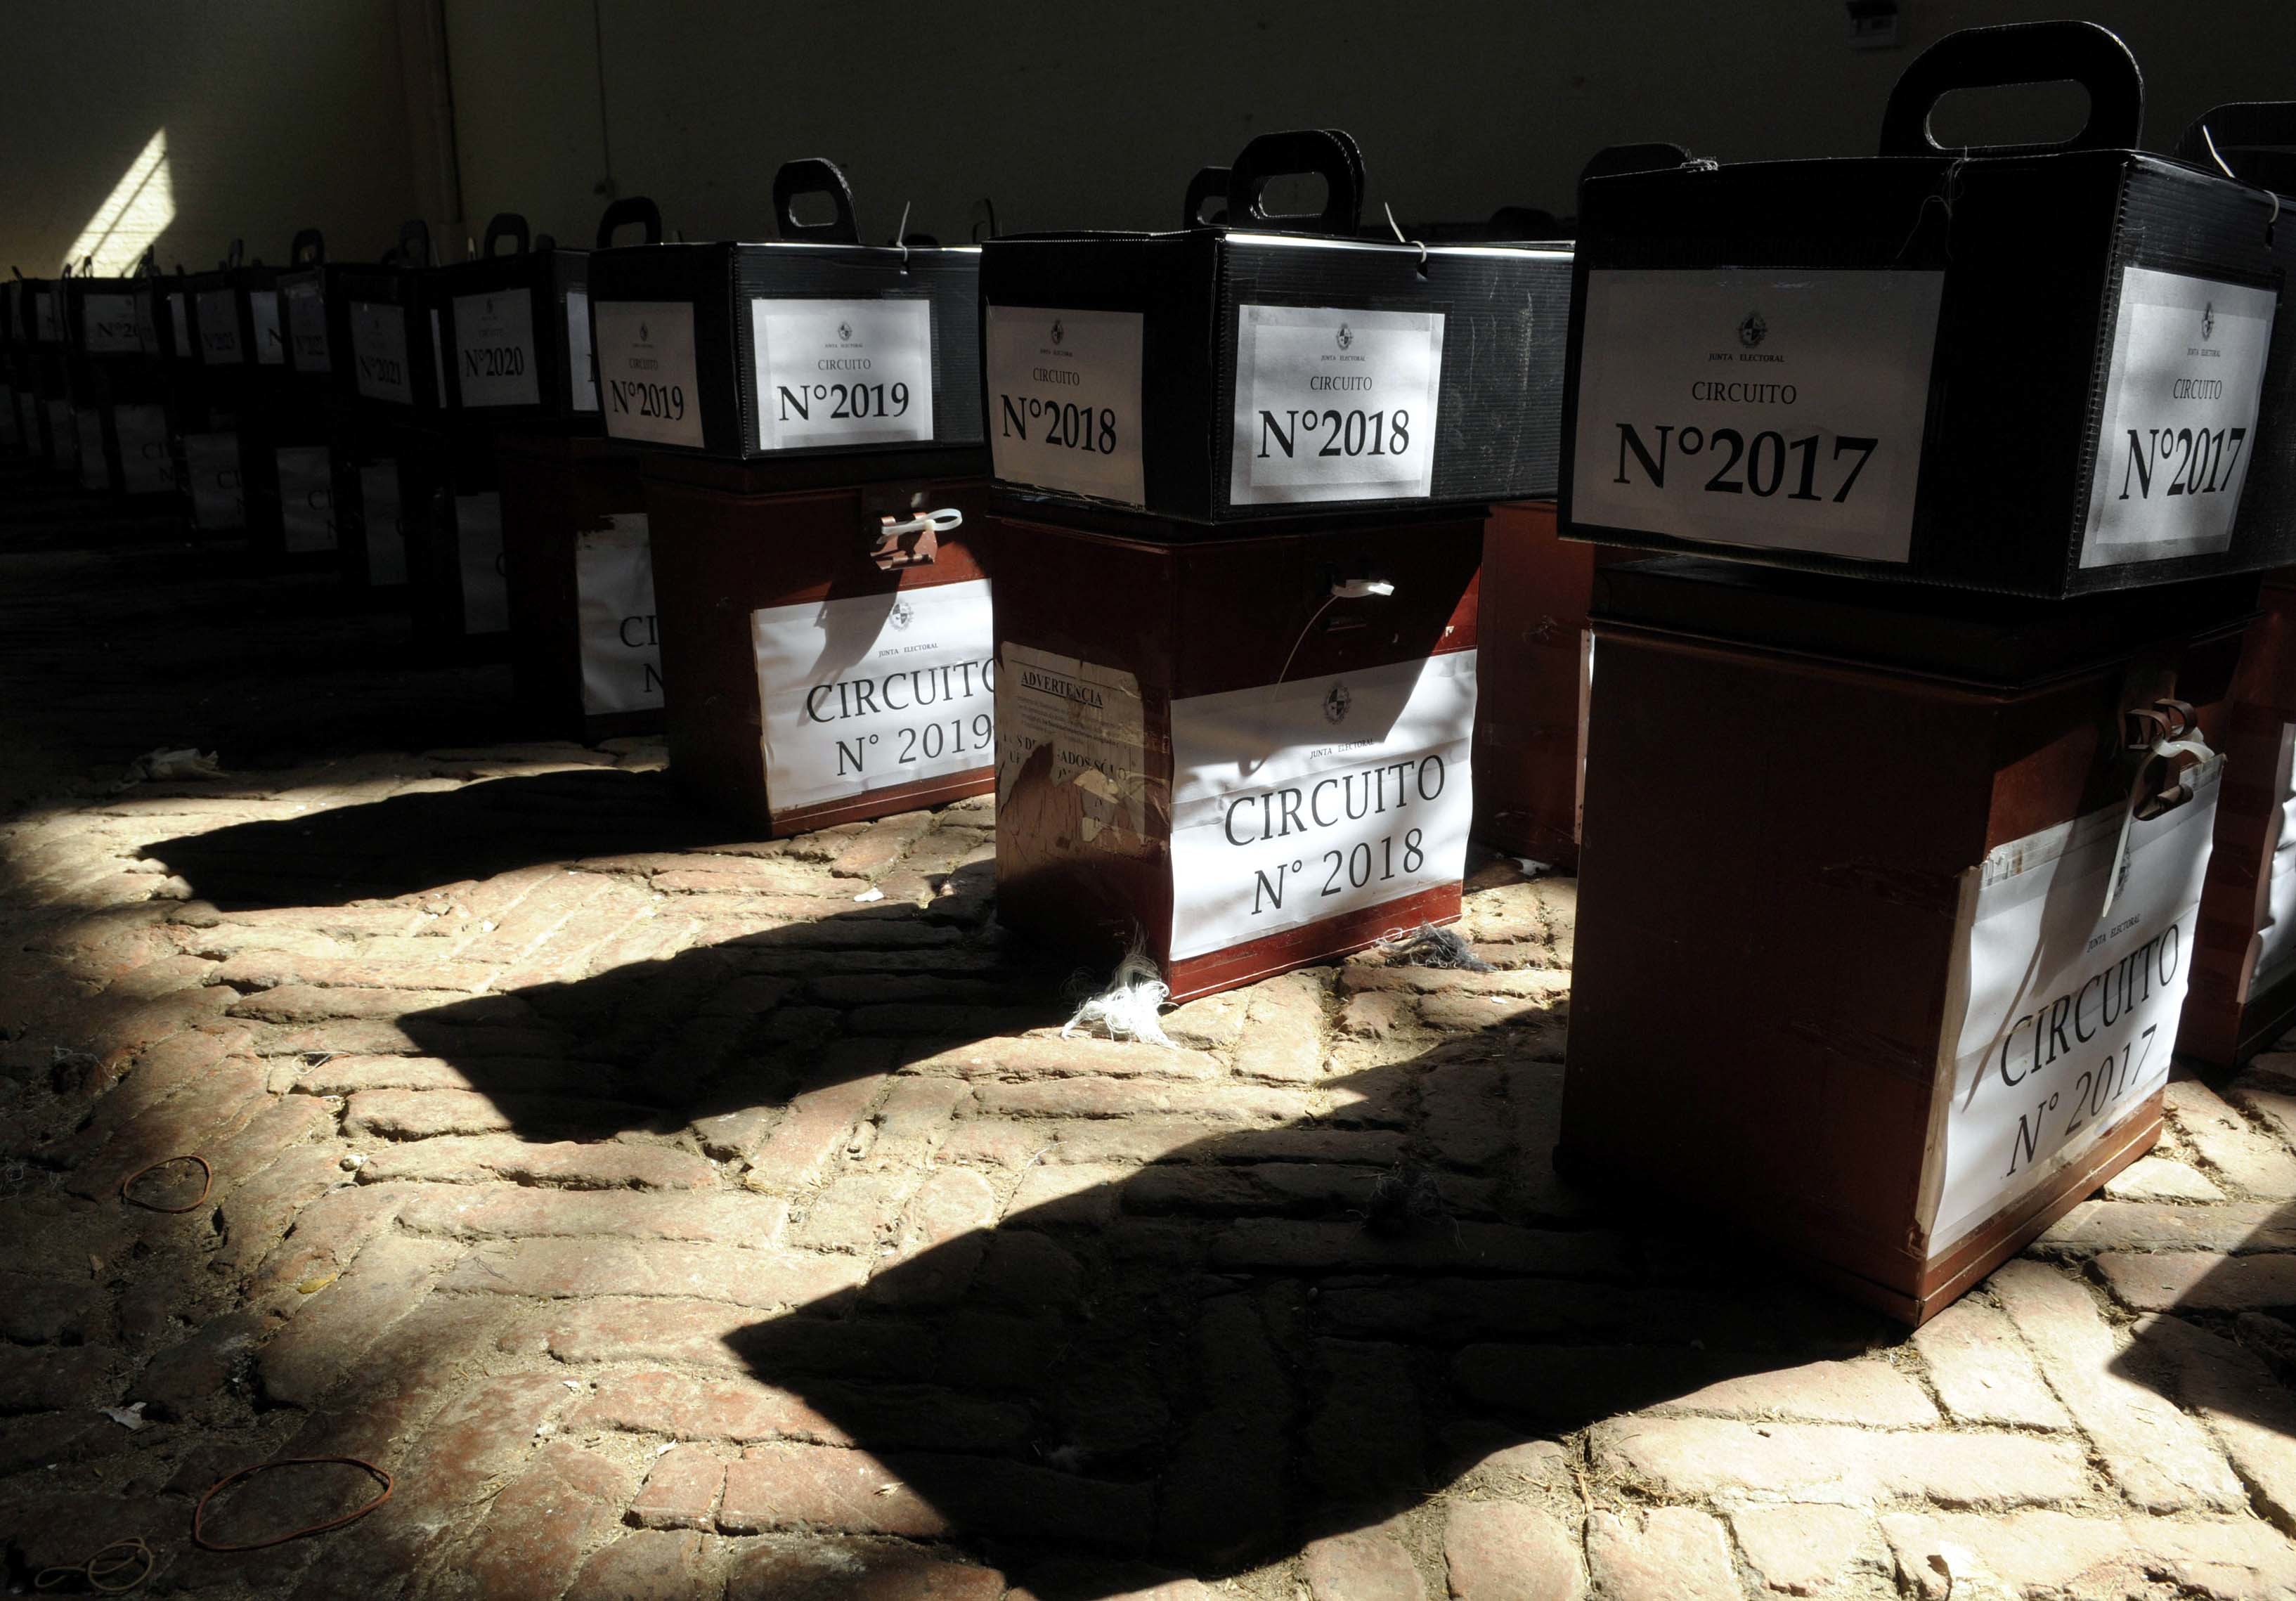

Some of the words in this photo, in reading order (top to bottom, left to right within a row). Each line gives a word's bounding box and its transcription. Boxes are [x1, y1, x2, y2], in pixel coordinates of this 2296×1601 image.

[464, 346, 524, 377] N°2020
[817, 358, 871, 371] CIRCUITO
[1033, 368, 1080, 386] CIRCUITO
[1708, 353, 1733, 362] JUNTA
[1739, 354, 1785, 363] ELECTORAL
[610, 380, 684, 420] N°2019
[777, 382, 909, 421] N°2019
[1310, 376, 1373, 391] CIRCUITO
[1692, 381, 1797, 404] CIRCUITO
[2174, 379, 2222, 400] CIRCUITO
[1001, 394, 1116, 455] N°2018
[1257, 409, 1410, 458] N°2018
[1614, 423, 1879, 503] N°2017
[2119, 427, 2247, 500] N°2017
[878, 648, 899, 657] JUNTA
[904, 642, 939, 654] ELECTORAL
[1021, 672, 1103, 706] ADVERTENCIA
[836, 734, 878, 776] N°
[898, 713, 993, 764] 2019
[1310, 747, 1332, 760] JUNTA
[1338, 739, 1375, 753] ELECTORAL
[1225, 755, 1445, 846] CIRCUITO
[1251, 860, 1302, 915] N°
[1321, 828, 1424, 897] 2018
[2087, 935, 2107, 954] JUNTA
[2110, 914, 2141, 938] ELECTORAL
[2001, 923, 2179, 1087] CIRCUITO
[2006, 1091, 2059, 1177] N°
[2065, 1023, 2158, 1136] 2017
